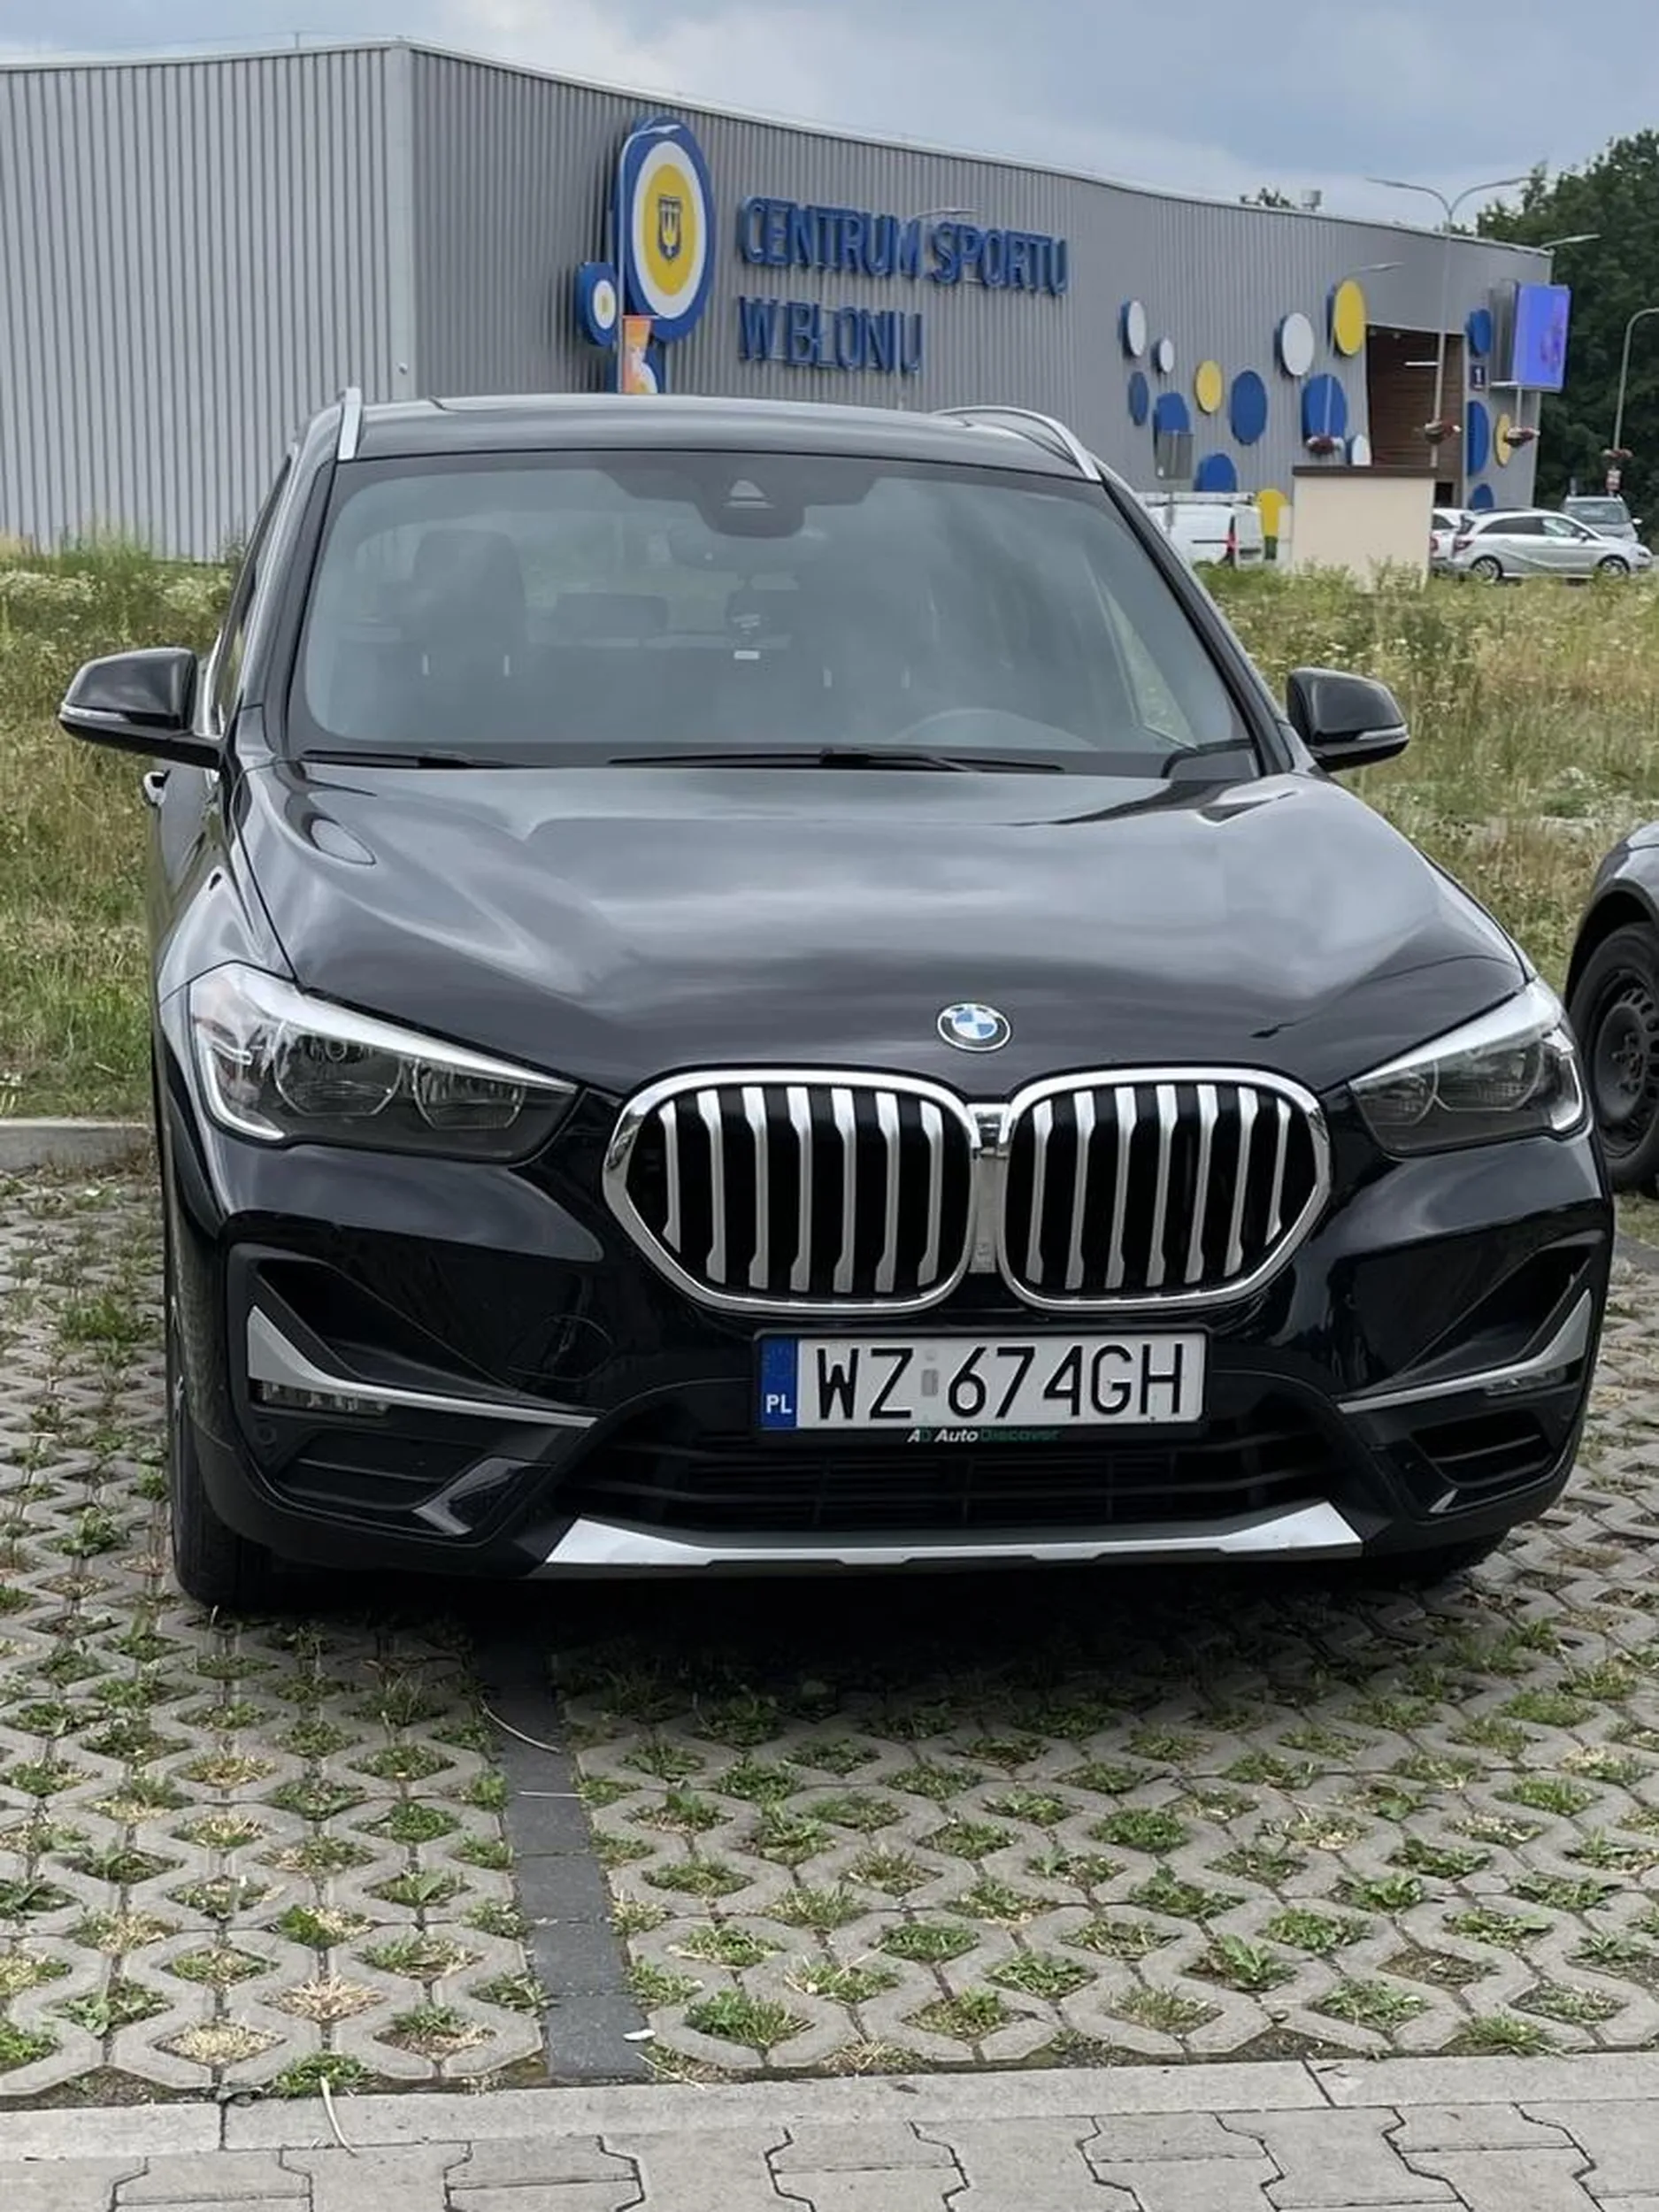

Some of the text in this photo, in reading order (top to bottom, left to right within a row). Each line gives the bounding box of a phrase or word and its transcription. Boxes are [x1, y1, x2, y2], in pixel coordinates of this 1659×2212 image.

[741, 196, 1068, 296] CENTRUM SPORTU
[738, 296, 780, 360] W
[765, 1394, 793, 1414] PL
[816, 1343, 1184, 1420] WZ 674GH
